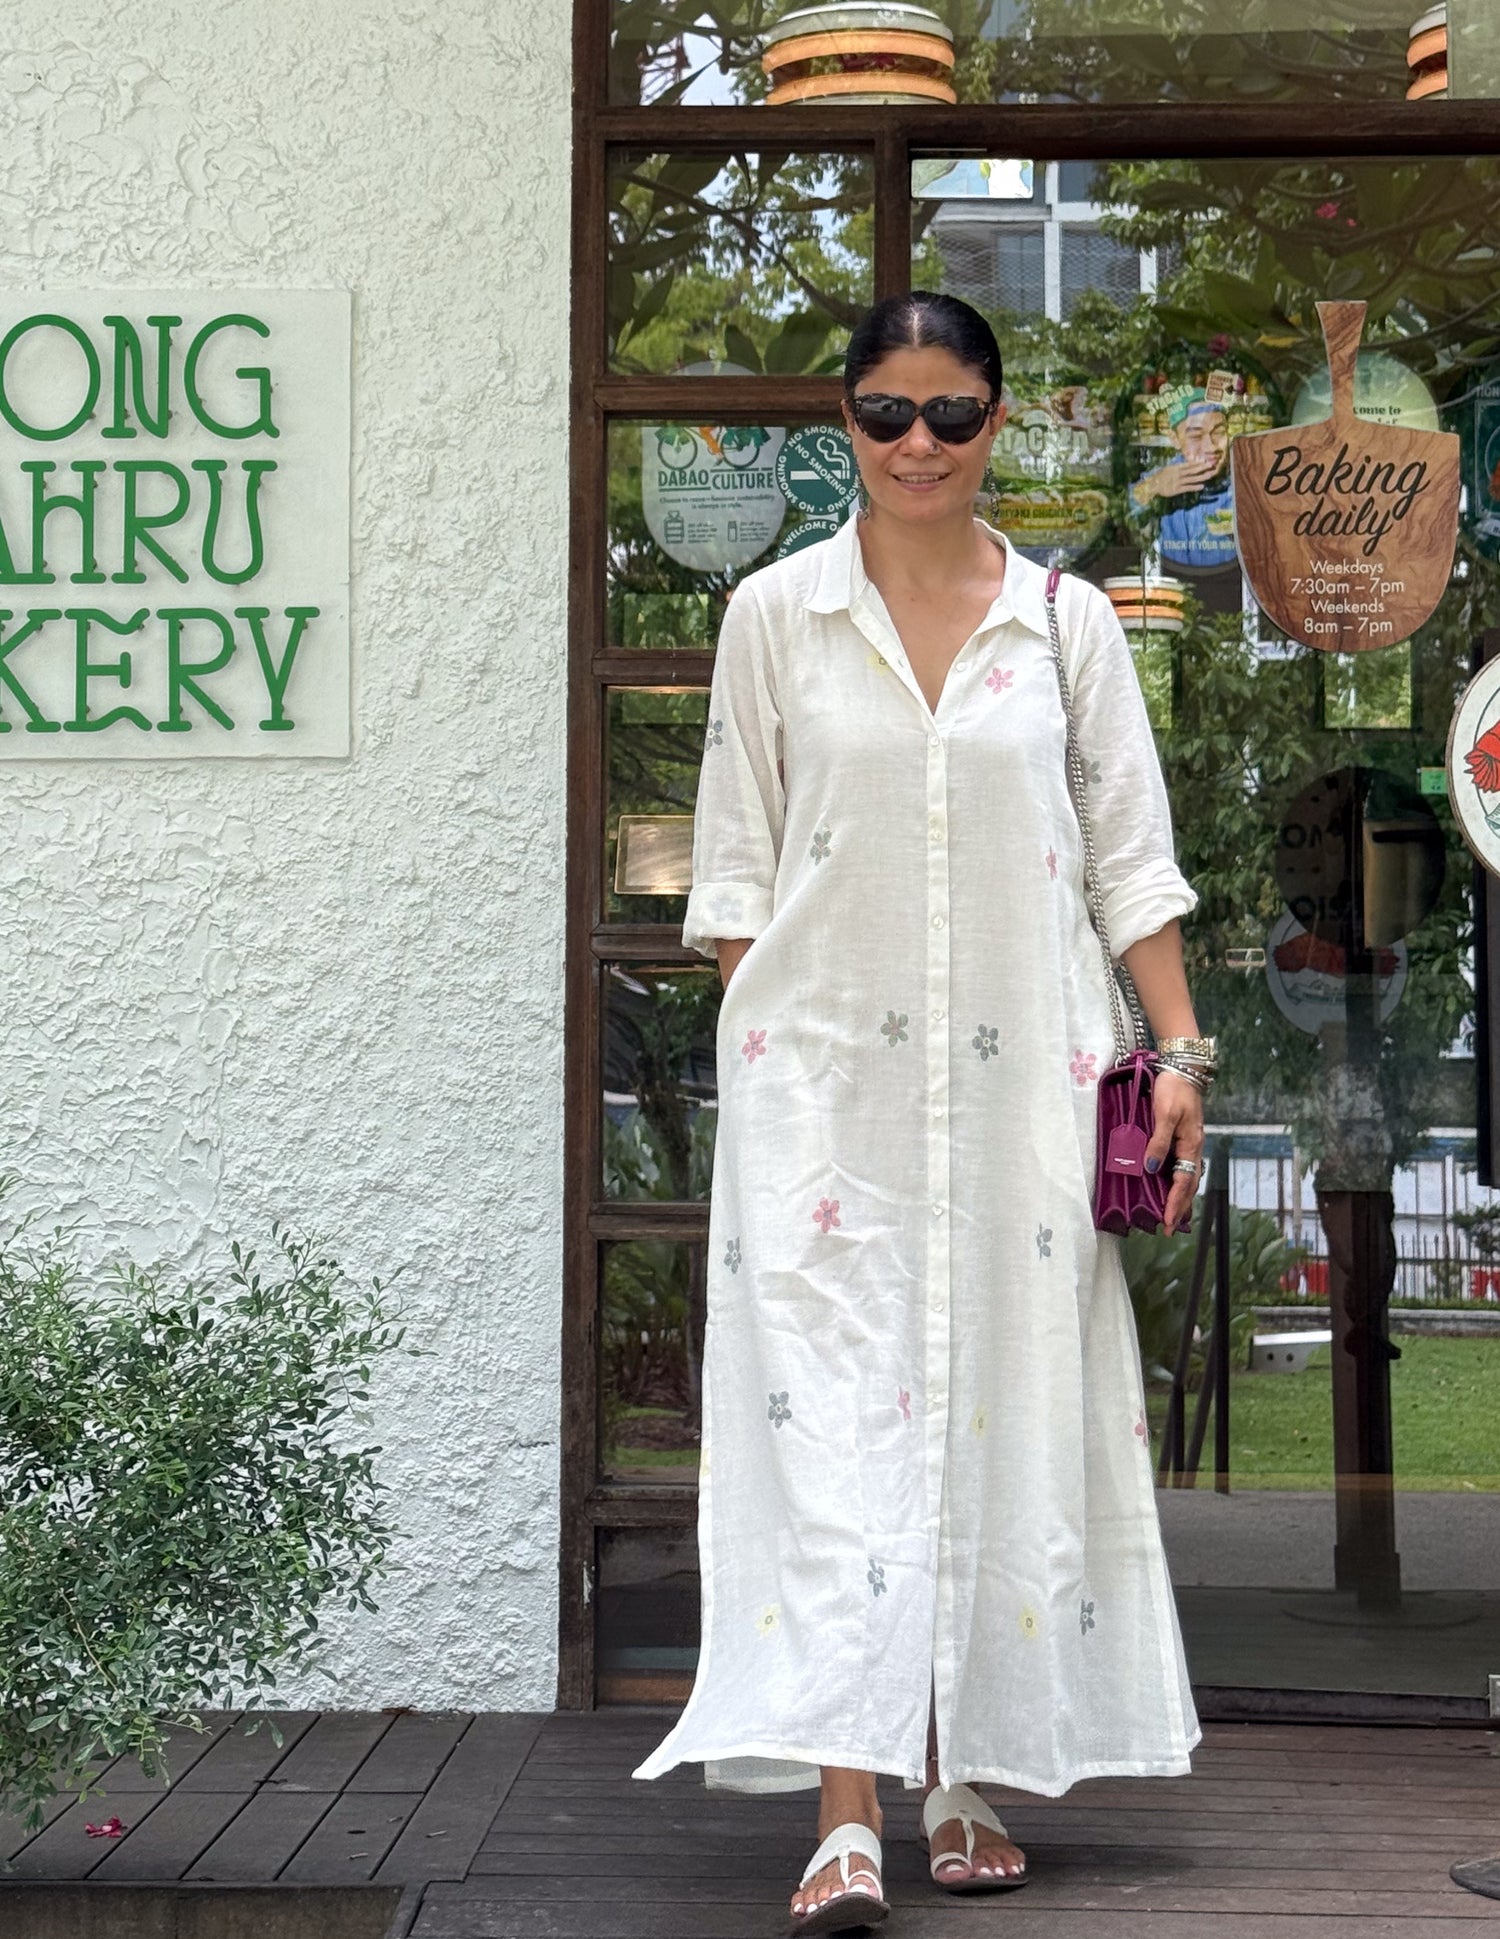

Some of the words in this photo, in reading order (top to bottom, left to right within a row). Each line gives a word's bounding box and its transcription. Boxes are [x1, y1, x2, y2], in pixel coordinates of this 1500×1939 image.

[0, 313, 281, 441] ONG
[1389, 405, 1401, 415] to
[787, 432, 803, 448] NO
[804, 425, 852, 445] SMOKING
[658, 469, 710, 487] DABAO
[712, 472, 774, 490] CULTURE
[777, 455, 798, 504] SMOKING
[795, 443, 810, 459] NO
[808, 457, 847, 496] SMOKING
[1264, 442, 1431, 521] Baking
[798, 501, 815, 513] NO
[783, 521, 826, 546] WELCOME
[1293, 496, 1394, 557] daily
[1309, 558, 1384, 577] Weekdays
[1290, 577, 1350, 595] 7:30am
[1369, 576, 1405, 597] 7pm
[1310, 597, 1385, 614] Weekends
[1304, 617, 1338, 634] 8am
[1357, 616, 1393, 637] 7pm
[0, 606, 320, 733] KERY
